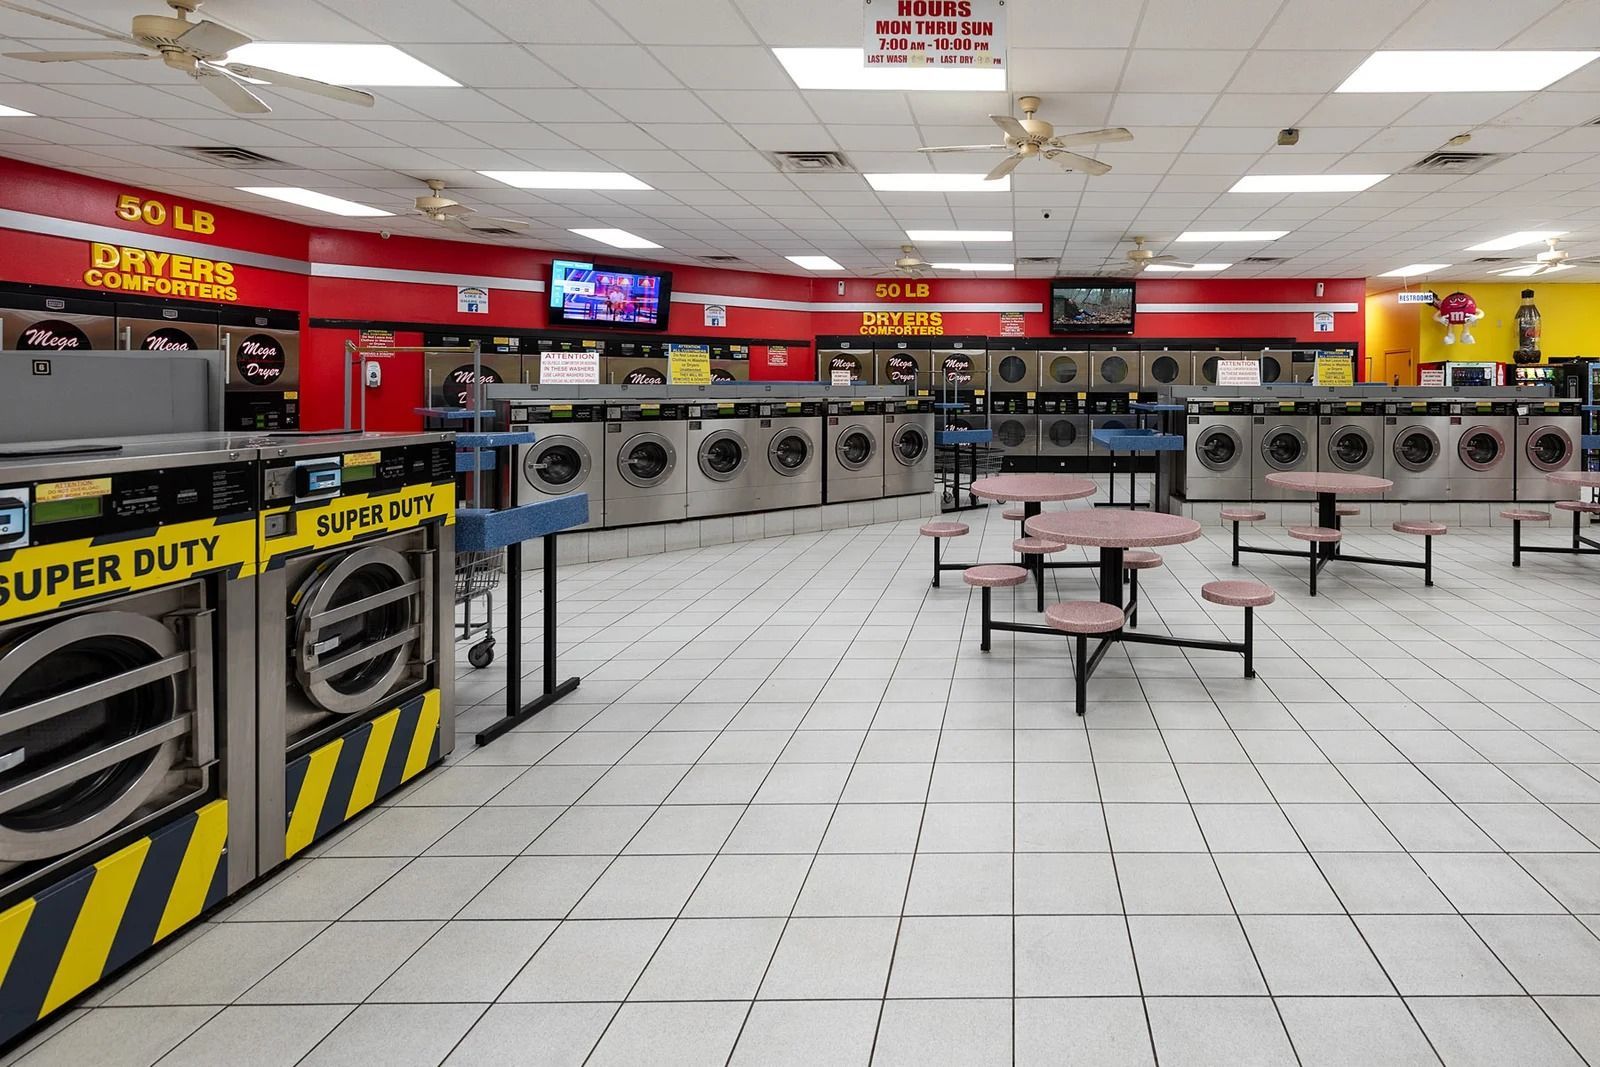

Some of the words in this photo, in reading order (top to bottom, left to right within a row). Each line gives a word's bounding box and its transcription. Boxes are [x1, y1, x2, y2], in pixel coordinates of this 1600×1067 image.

[898, 0, 971, 17] HOURS
[876, 20, 911, 35] MON
[915, 21, 957, 35] THRU
[961, 21, 993, 36] SUN
[879, 38, 908, 51] 7:00
[910, 42, 925, 50] AM
[934, 38, 972, 51] 10:00
[974, 42, 989, 51] PM
[867, 55, 884, 63] LAST
[886, 55, 908, 63] WASH
[940, 55, 957, 63] LAST
[117, 194, 166, 226] 50
[173, 206, 216, 235] LB
[91, 242, 235, 286] DRYERS
[83, 269, 238, 301] COMFORTERS
[875, 283, 901, 298] 50
[905, 283, 930, 298] LB
[1399, 294, 1433, 302] RESTROOMS
[863, 312, 943, 326] DRYERS
[1450, 312, 1465, 321] m
[860, 326, 944, 336] COMFORTERS
[26, 329, 79, 351] Mega
[242, 341, 277, 360] Mega
[832, 358, 856, 370] Mega
[889, 358, 913, 370] Mega
[945, 359, 969, 370] Mega
[246, 363, 280, 380] Dryer
[454, 371, 495, 384] Mga
[891, 371, 915, 382] Dryer
[947, 372, 971, 383] Dryer
[317, 504, 384, 537] SUPER
[389, 493, 434, 521] DUTY
[134, 535, 220, 577] DUTY
